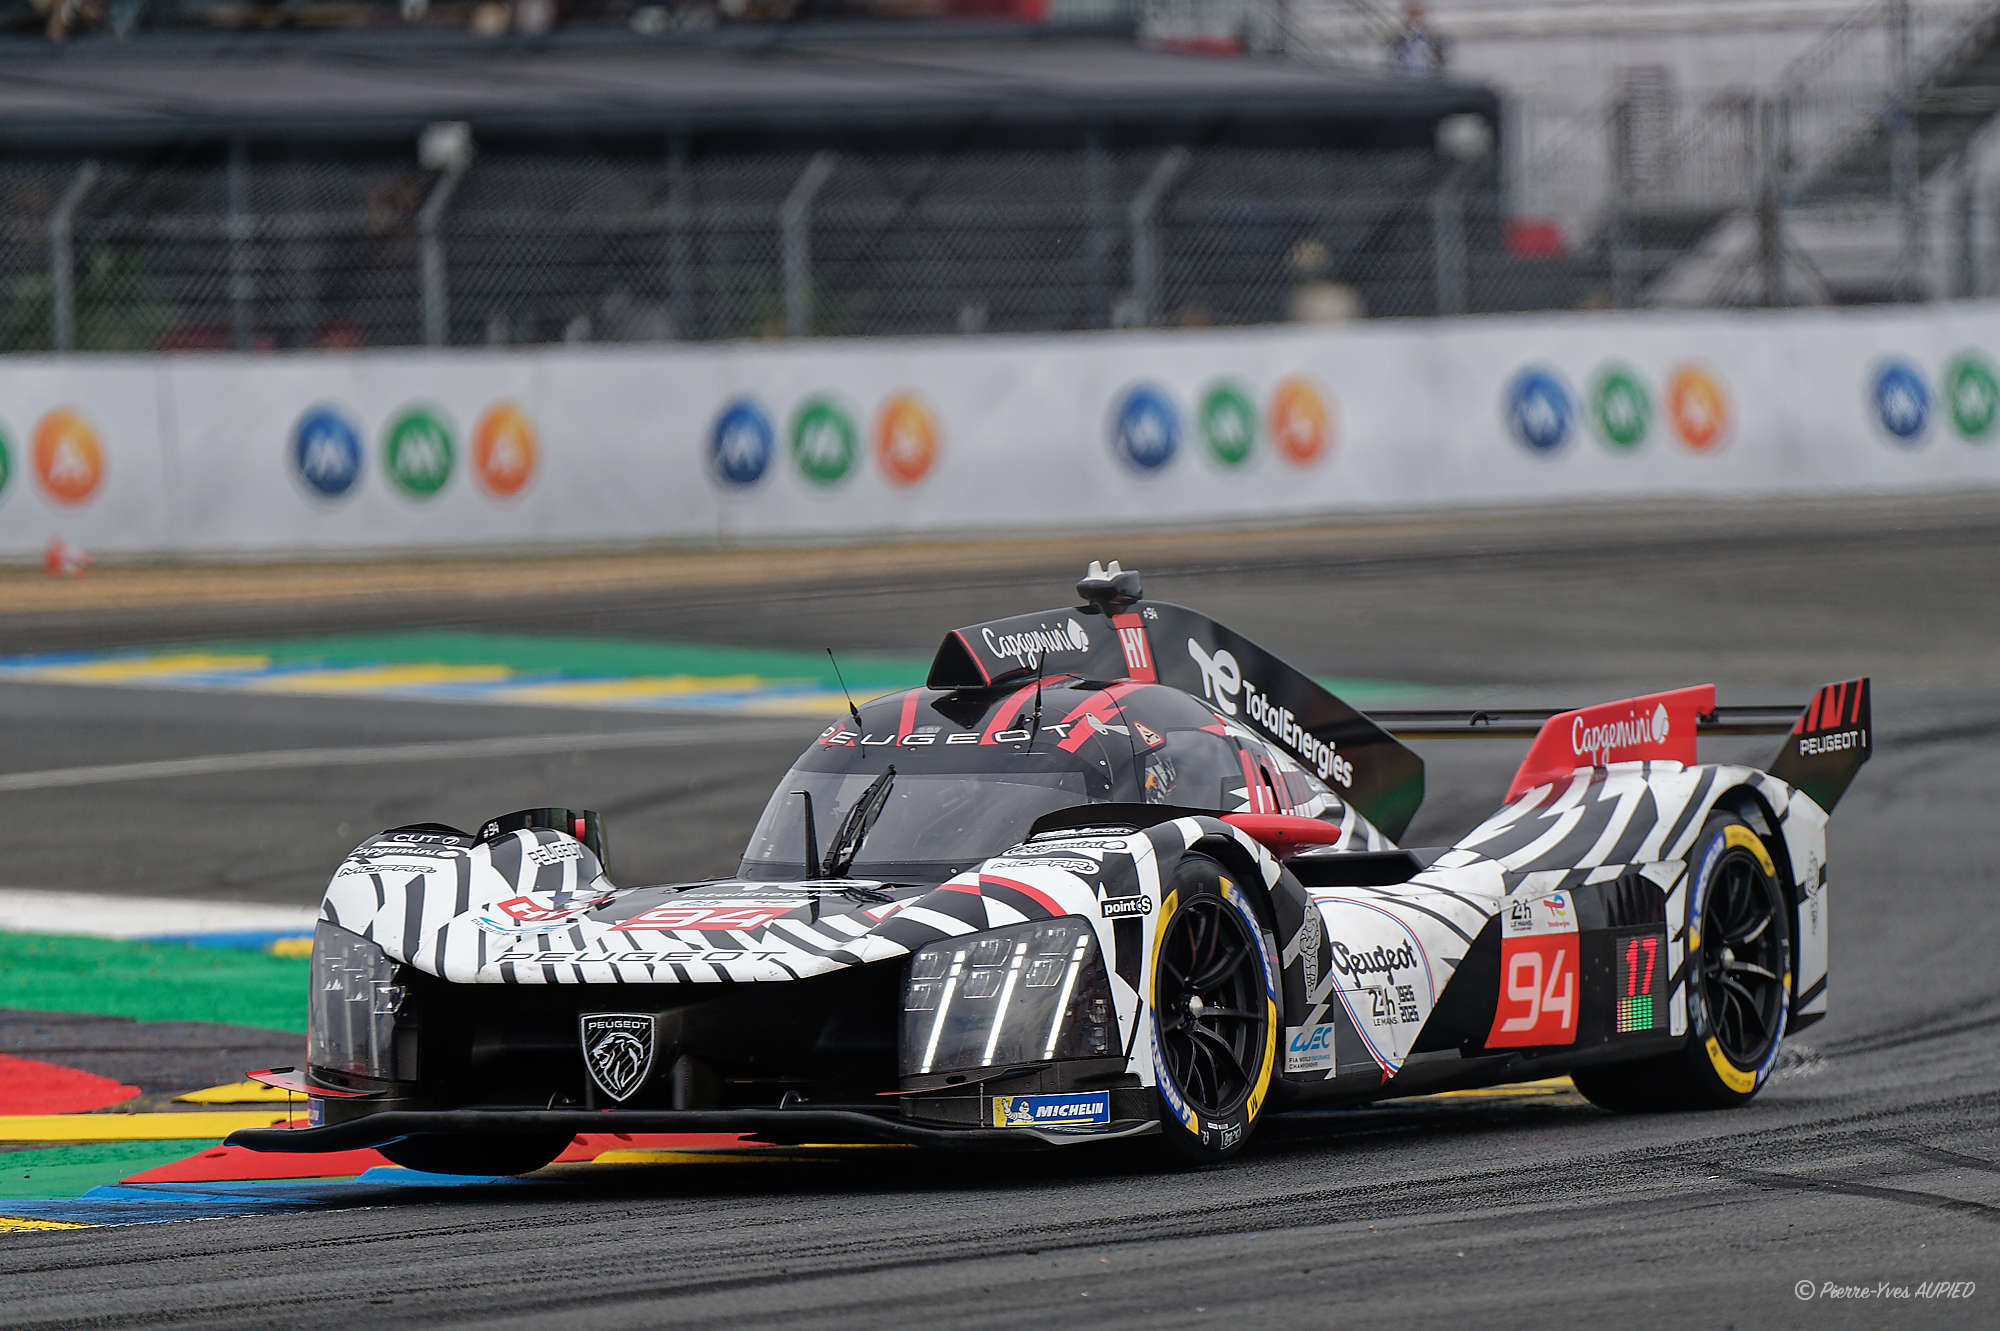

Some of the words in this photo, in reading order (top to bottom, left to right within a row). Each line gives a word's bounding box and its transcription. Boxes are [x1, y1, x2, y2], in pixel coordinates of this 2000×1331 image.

[981, 622, 1074, 670] Capgemini
[1120, 627, 1147, 668] HY
[820, 723, 1072, 746] PEUGEOT
[1242, 680, 1353, 788] TotalEnergies
[1571, 709, 1652, 766] Capgemini
[1800, 731, 1858, 756] PEUGEOT
[528, 841, 584, 868] PEUGEOT
[622, 909, 774, 928] 94
[494, 951, 788, 963] PEUGEOT
[1331, 938, 1417, 988] Peugeot
[1625, 938, 1657, 996] 17
[1500, 949, 1573, 1032] 94
[587, 1019, 650, 1031] PEUGEOT
[1035, 1101, 1104, 1118] MICHELIN
